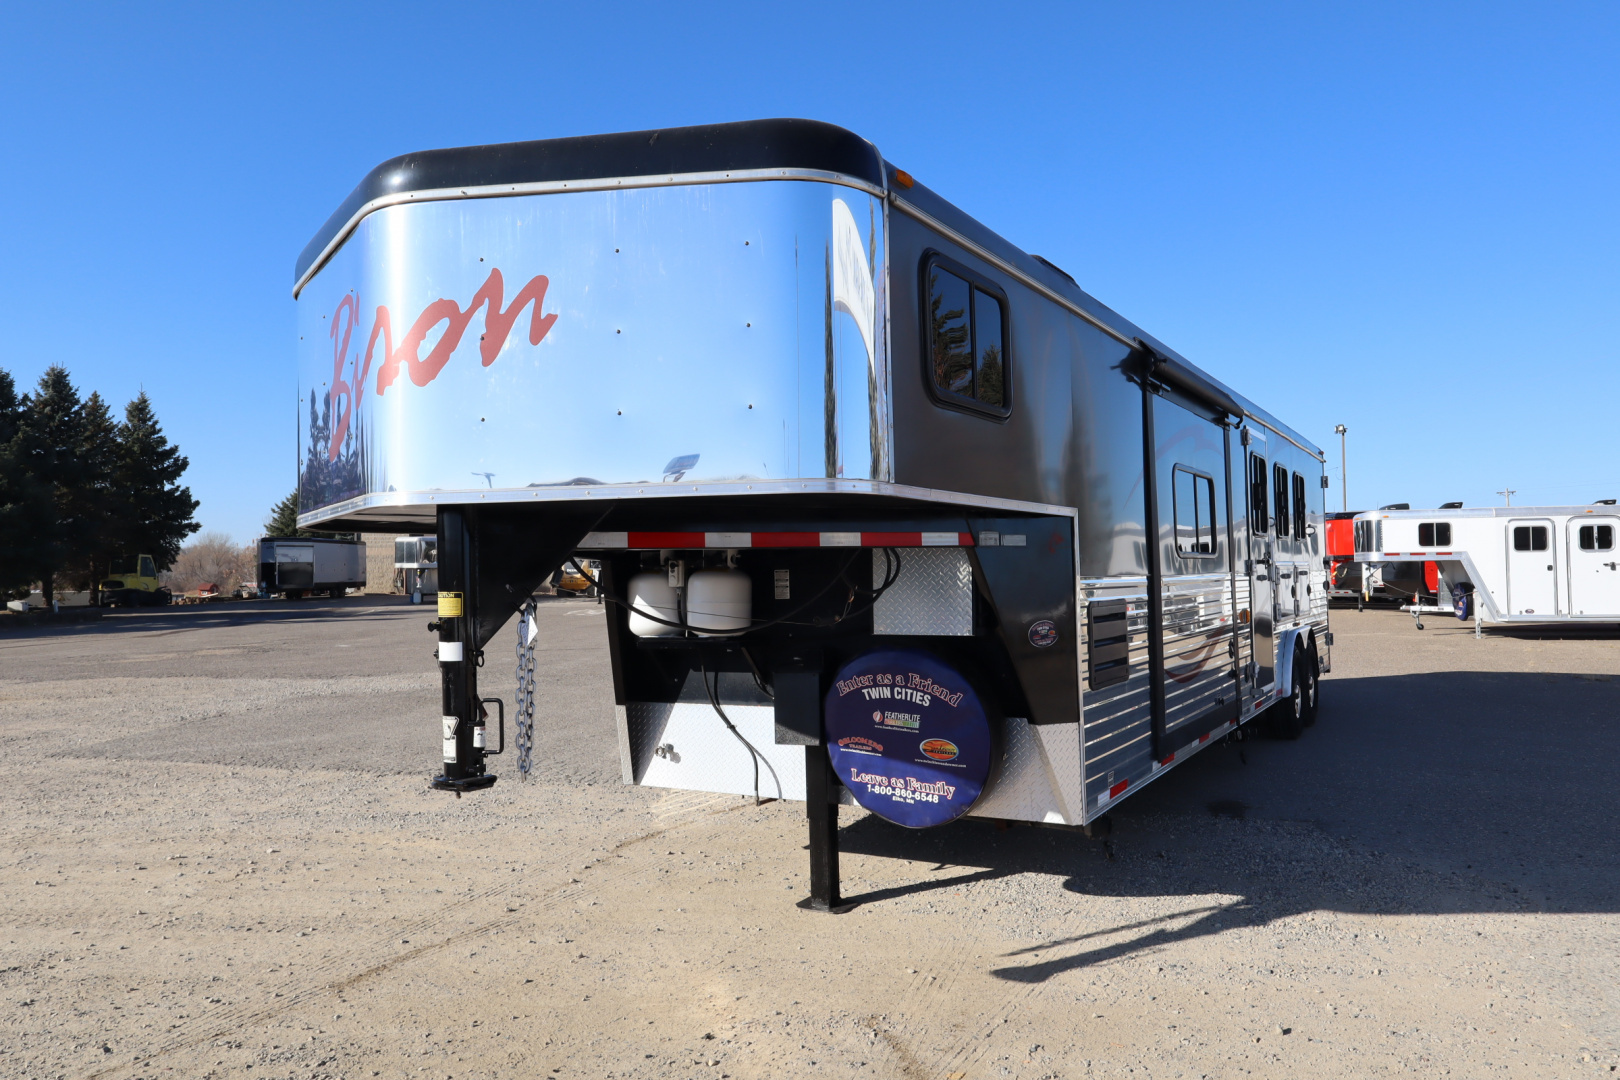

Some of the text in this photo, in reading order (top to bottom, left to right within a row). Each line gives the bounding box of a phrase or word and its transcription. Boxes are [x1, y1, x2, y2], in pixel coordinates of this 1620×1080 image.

[329, 267, 559, 462] Bison
[836, 672, 963, 707] Enter as a Friend
[862, 686, 931, 707] TWIN CITIES
[884, 711, 921, 723] FEATHERLITE
[850, 768, 956, 800] Leave as Family
[867, 784, 939, 804] 1-800-860-6548
